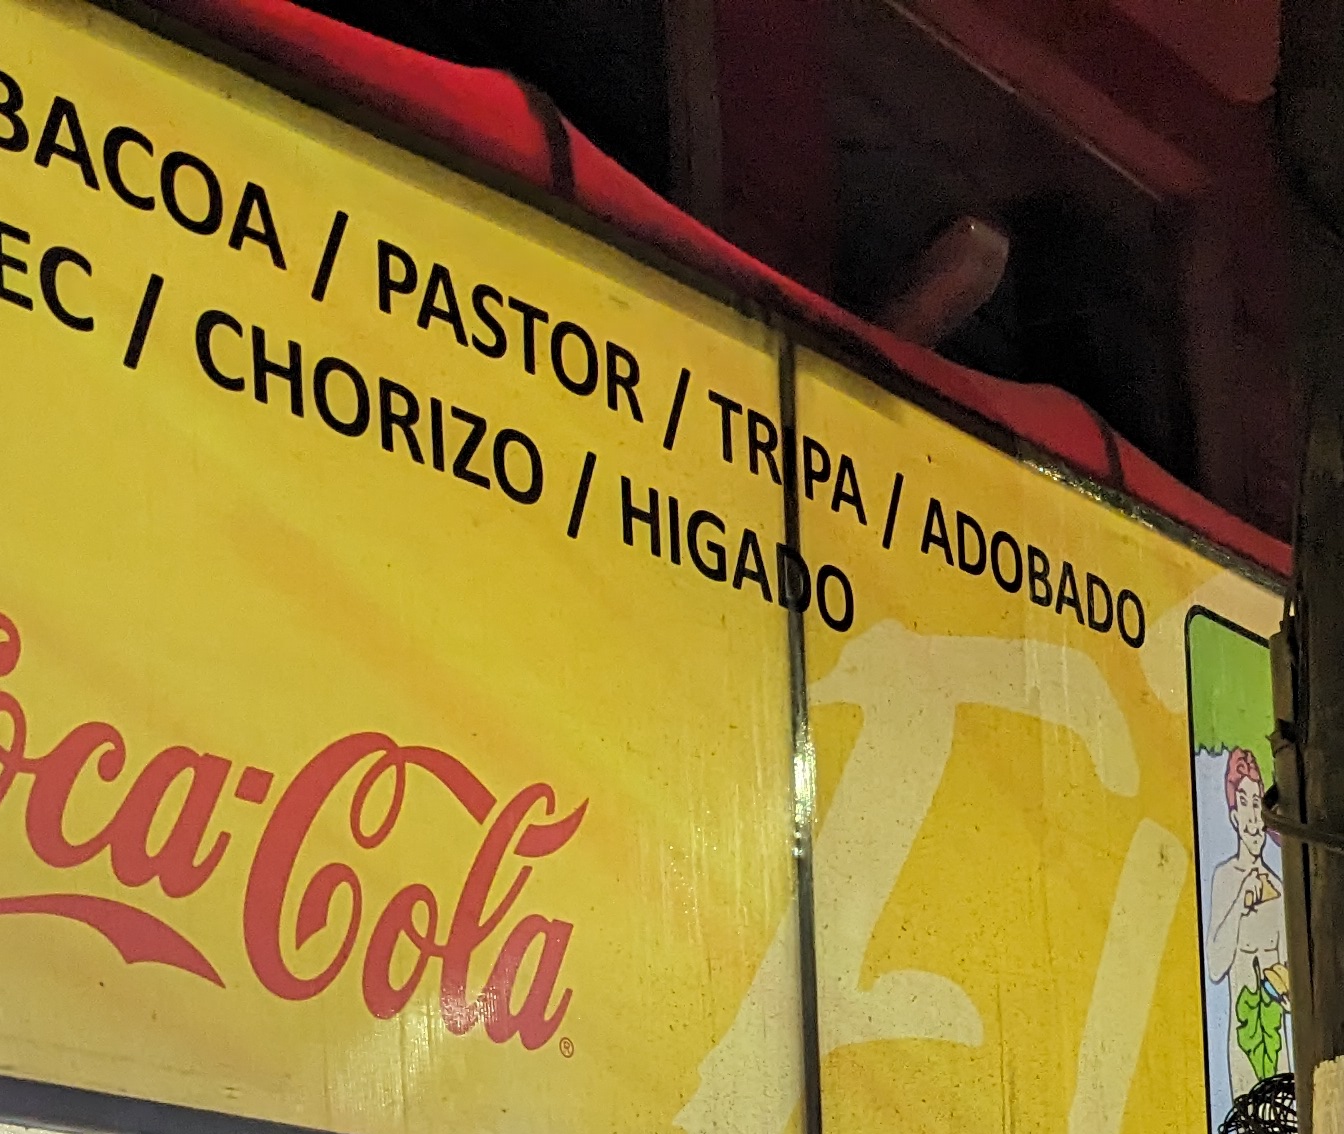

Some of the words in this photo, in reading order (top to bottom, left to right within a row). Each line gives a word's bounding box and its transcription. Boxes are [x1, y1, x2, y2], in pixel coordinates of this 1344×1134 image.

[194, 309, 545, 505] CHORIZO
[619, 474, 855, 633] HIGADO
[377, 238, 645, 422] PASTOR
[921, 497, 1147, 650] ADOBADO
